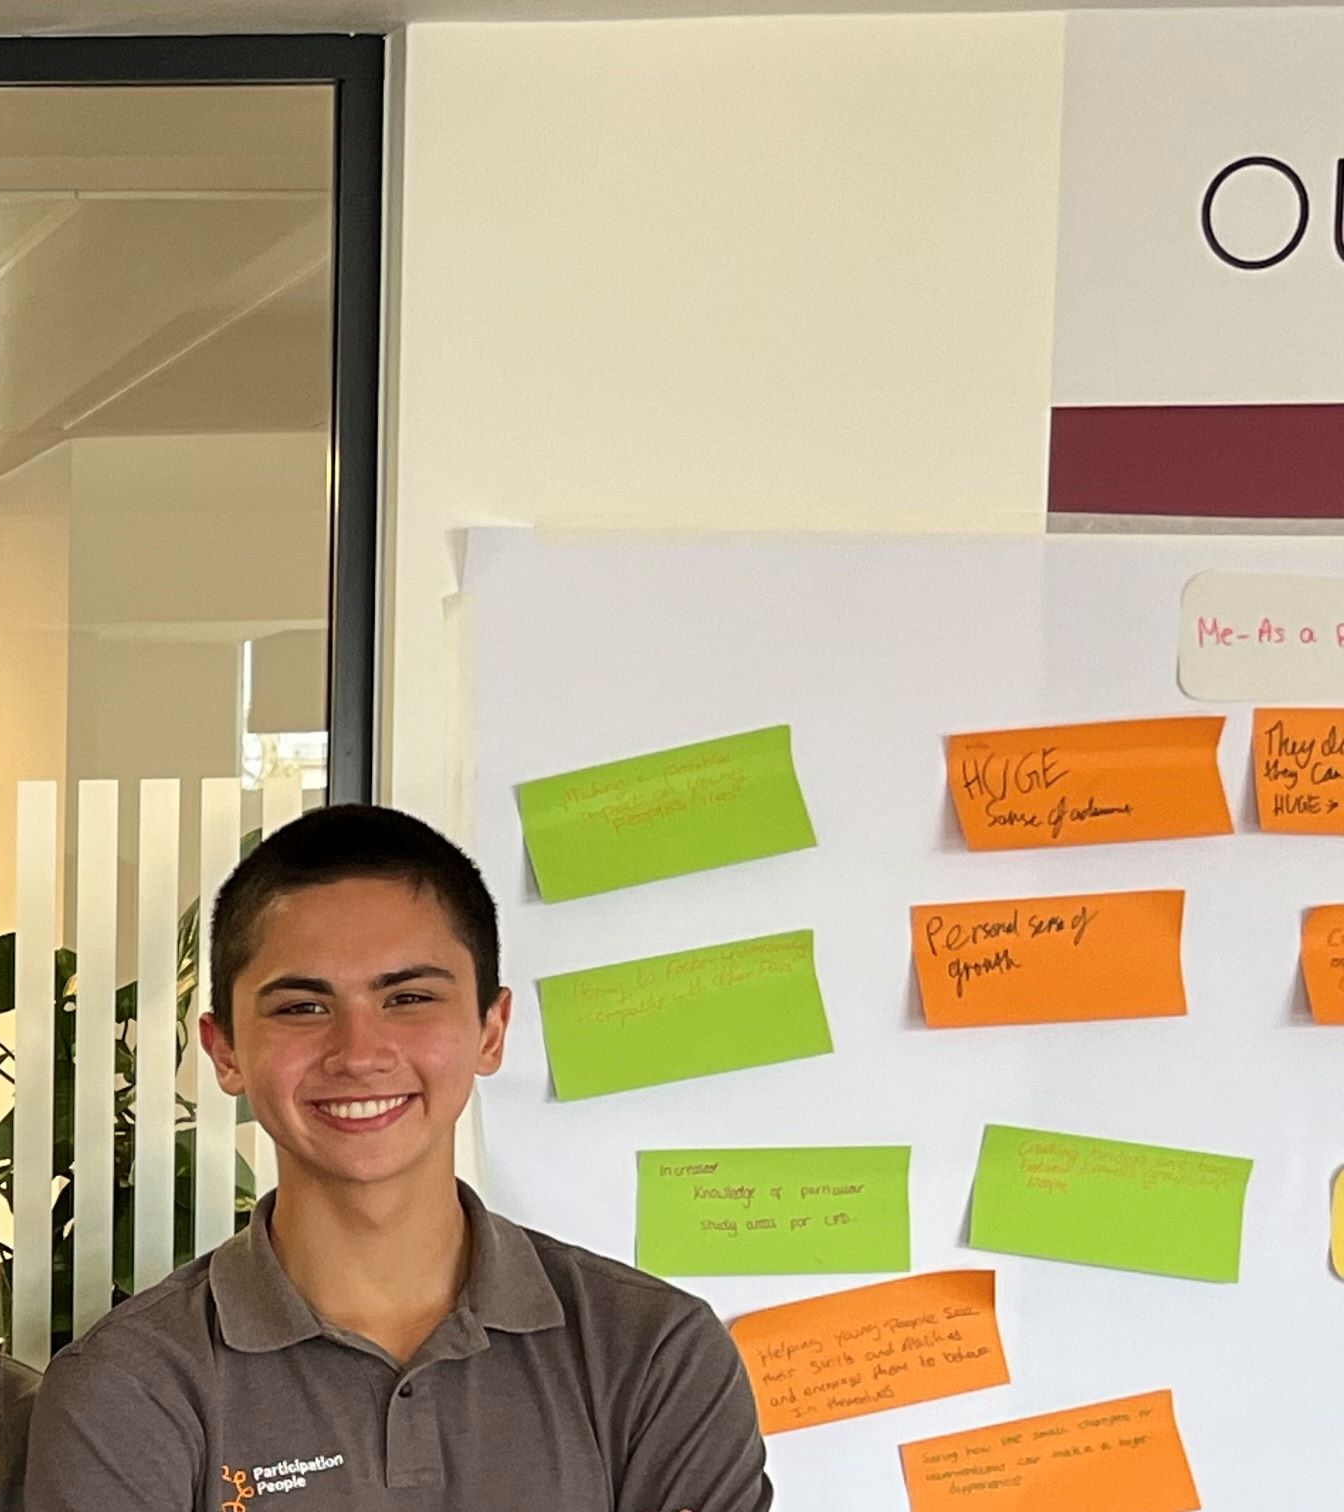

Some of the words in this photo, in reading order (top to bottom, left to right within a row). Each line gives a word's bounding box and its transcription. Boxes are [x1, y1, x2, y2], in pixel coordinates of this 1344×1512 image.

[1201, 156, 1344, 270] O
[1258, 618, 1286, 643] As
[1299, 627, 1317, 644] a
[962, 747, 1070, 801] HUGE
[1273, 794, 1322, 817] HUGE
[253, 1453, 344, 1481] Participation
[256, 1474, 306, 1495] People
